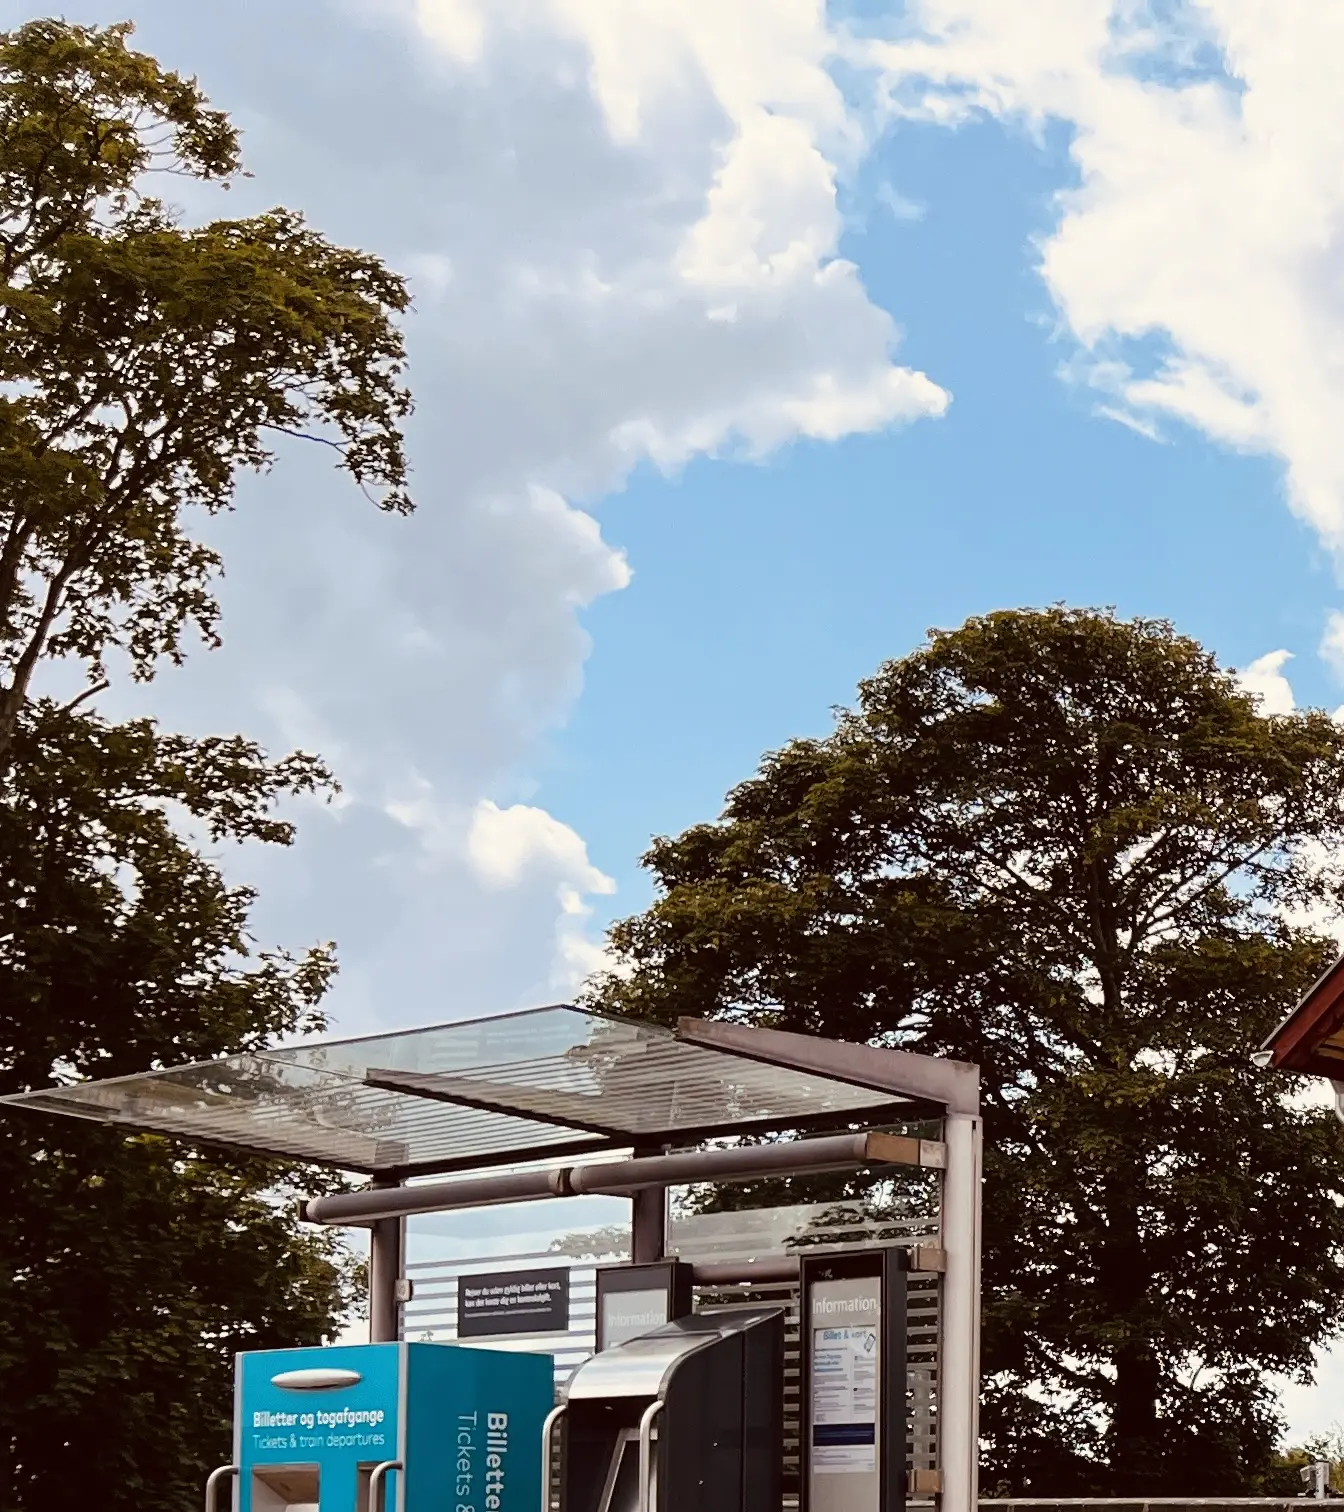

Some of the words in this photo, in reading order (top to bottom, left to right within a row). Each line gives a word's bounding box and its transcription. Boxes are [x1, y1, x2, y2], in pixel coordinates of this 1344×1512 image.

[812, 1295, 877, 1314] Information
[608, 1308, 665, 1328] Information
[253, 1411, 298, 1428] Billetter
[300, 1412, 315, 1429] og
[316, 1407, 384, 1428] togafgange
[252, 1433, 288, 1449] Tickets
[289, 1433, 297, 1448] &
[299, 1433, 324, 1448] train
[326, 1432, 385, 1450] departures
[455, 1411, 477, 1496] Tickets
